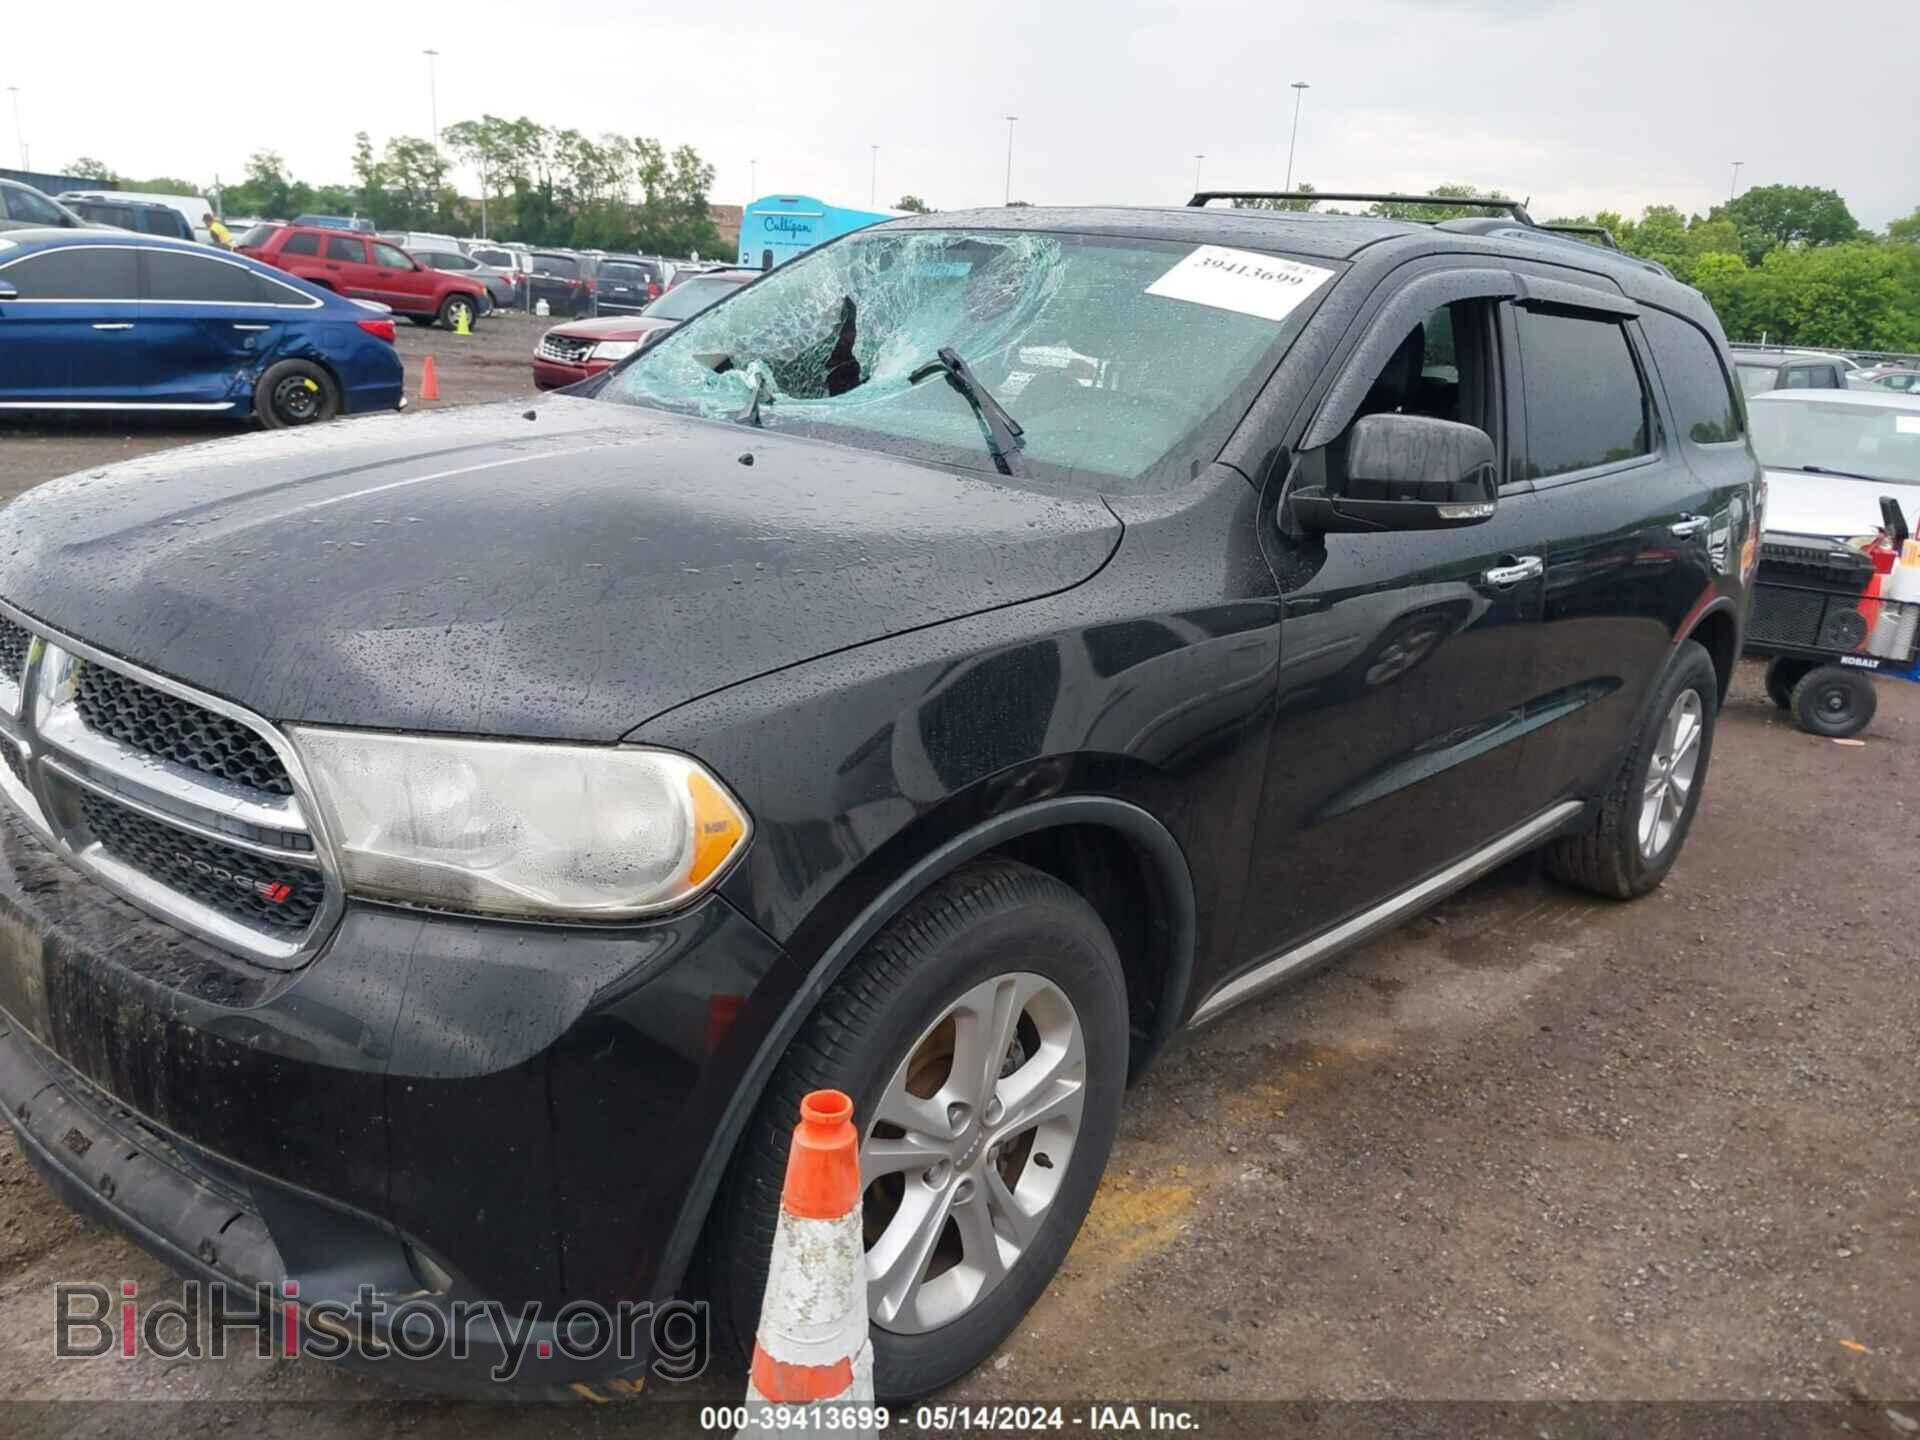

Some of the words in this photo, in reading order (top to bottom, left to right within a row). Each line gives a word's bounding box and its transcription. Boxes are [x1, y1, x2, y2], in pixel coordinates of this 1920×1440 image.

[764, 215, 811, 240] Culligan
[1841, 656, 1880, 668] KOBALT
[175, 852, 275, 897] DODGE
